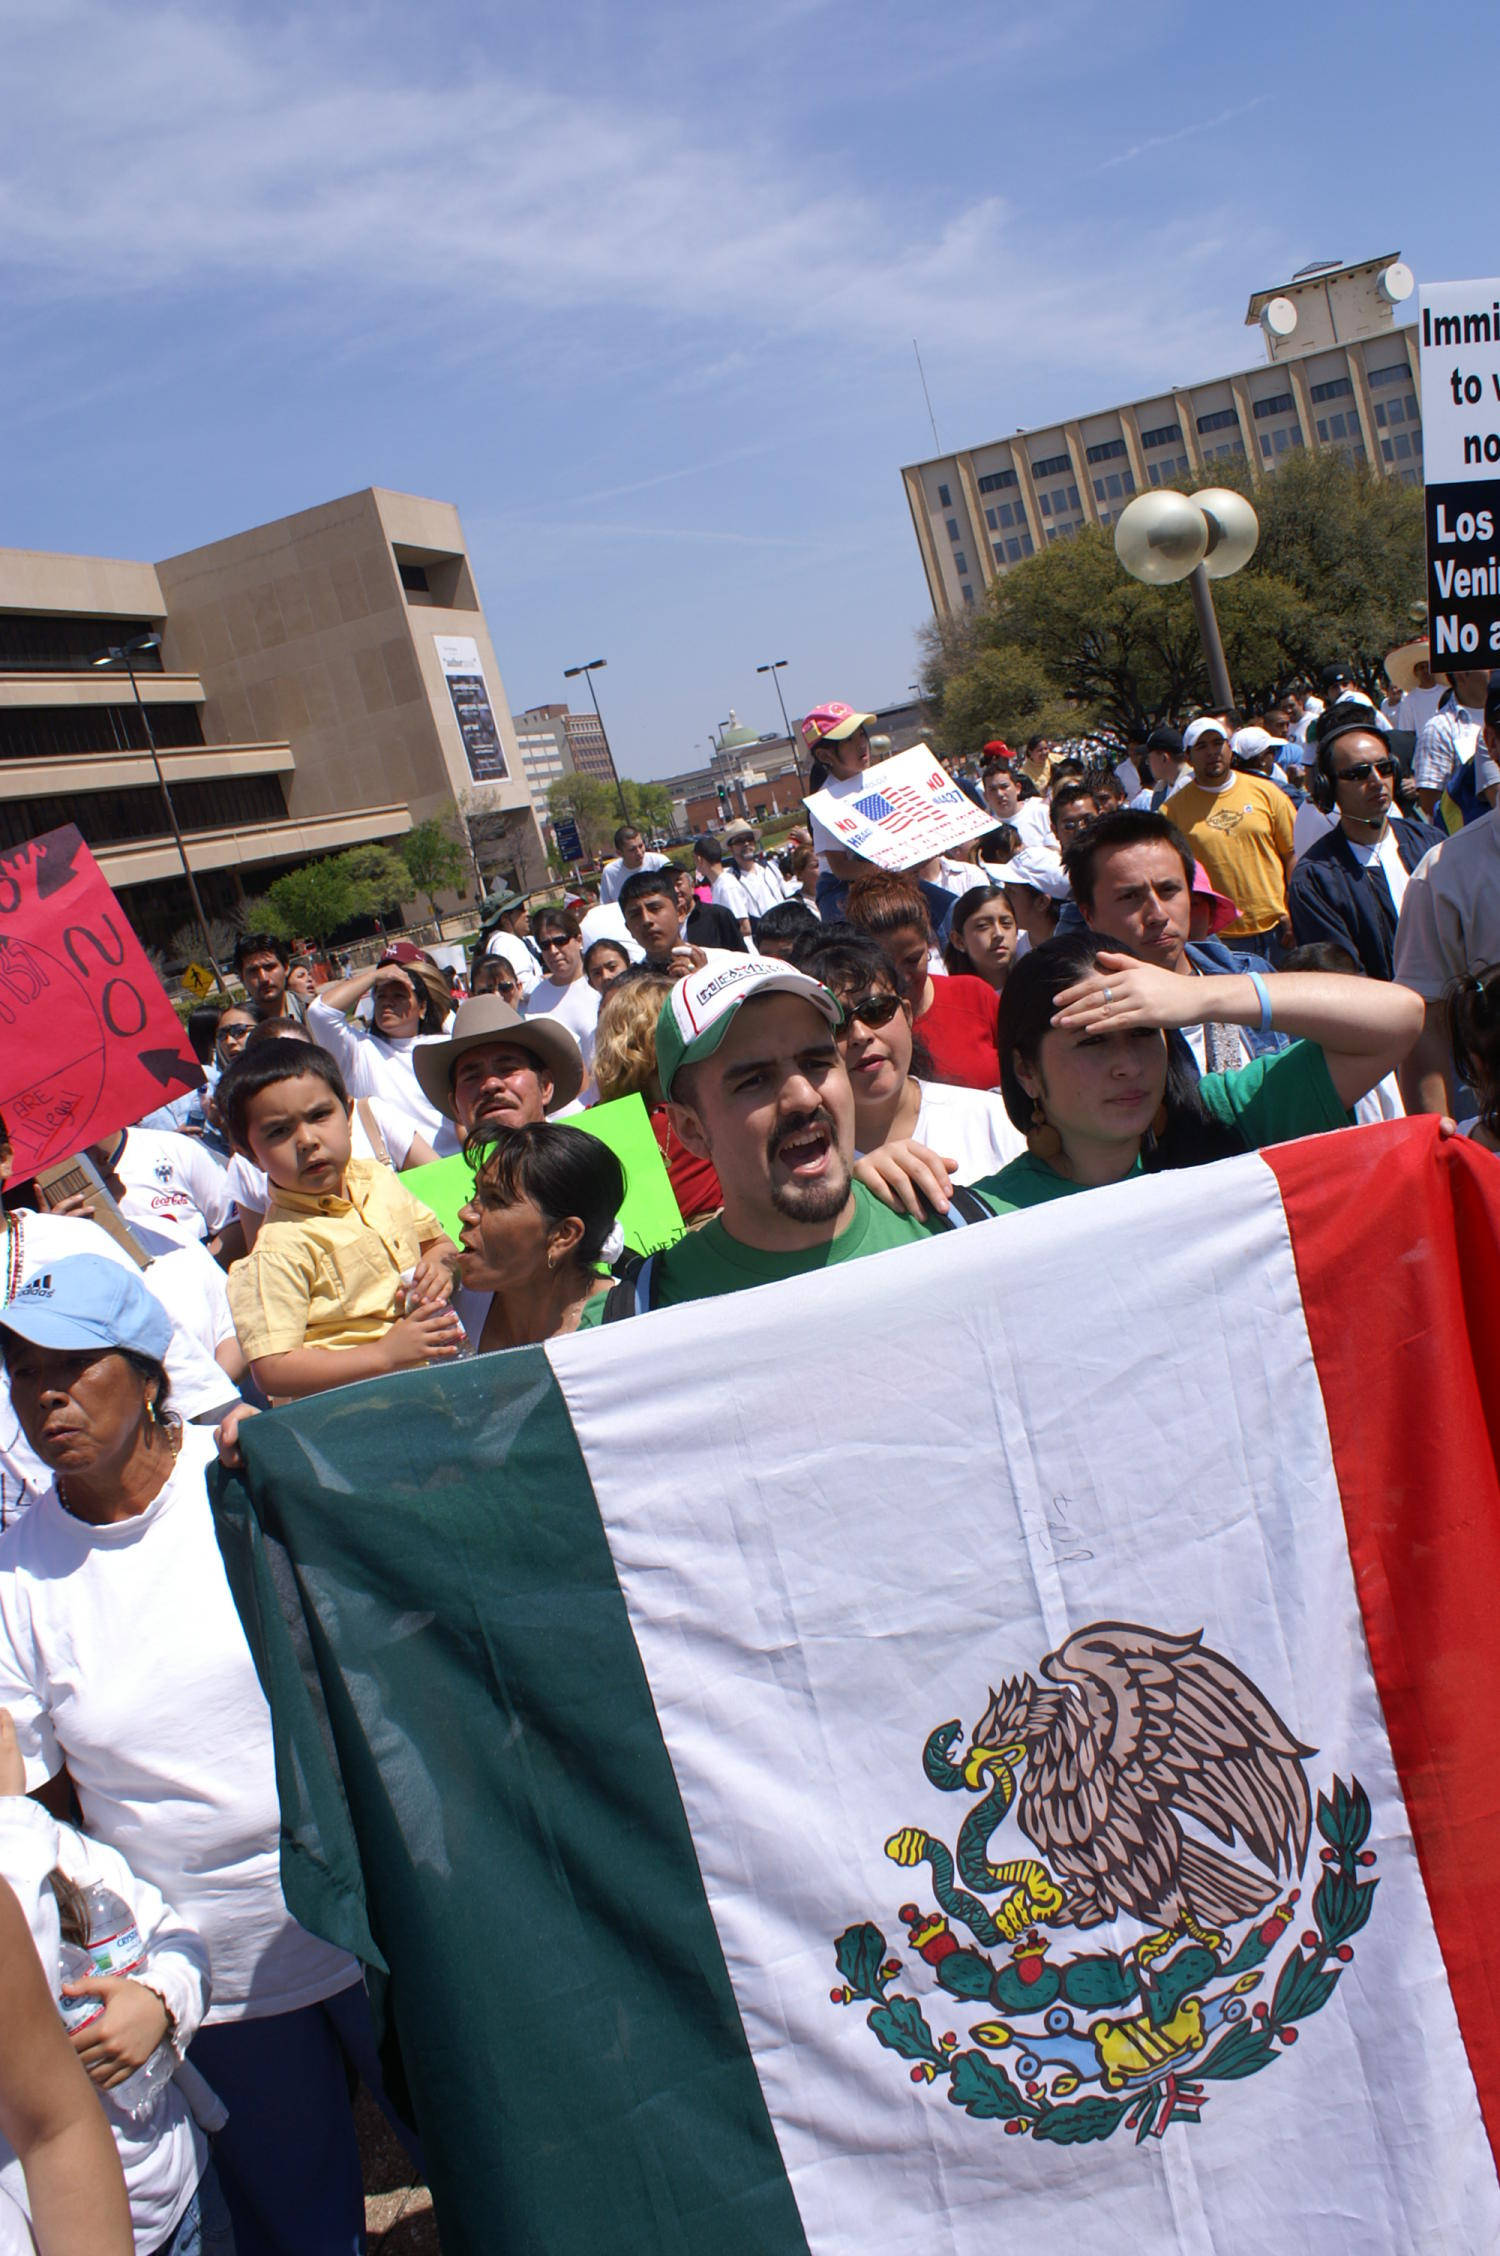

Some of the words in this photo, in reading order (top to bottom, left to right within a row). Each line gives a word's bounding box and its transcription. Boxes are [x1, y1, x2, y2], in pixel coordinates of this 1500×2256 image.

[1423, 302, 1500, 347] Immi
[1451, 367, 1482, 405] to
[1464, 434, 1500, 464] no
[1437, 504, 1494, 543] Los
[1434, 556, 1500, 599] Veni
[1436, 614, 1479, 654] No
[926, 772, 945, 791] NO
[834, 818, 858, 832] NO
[13, 1089, 54, 1118] ARE
[9, 1090, 82, 1158] Illegal
[17, 1284, 55, 1299] adidas
